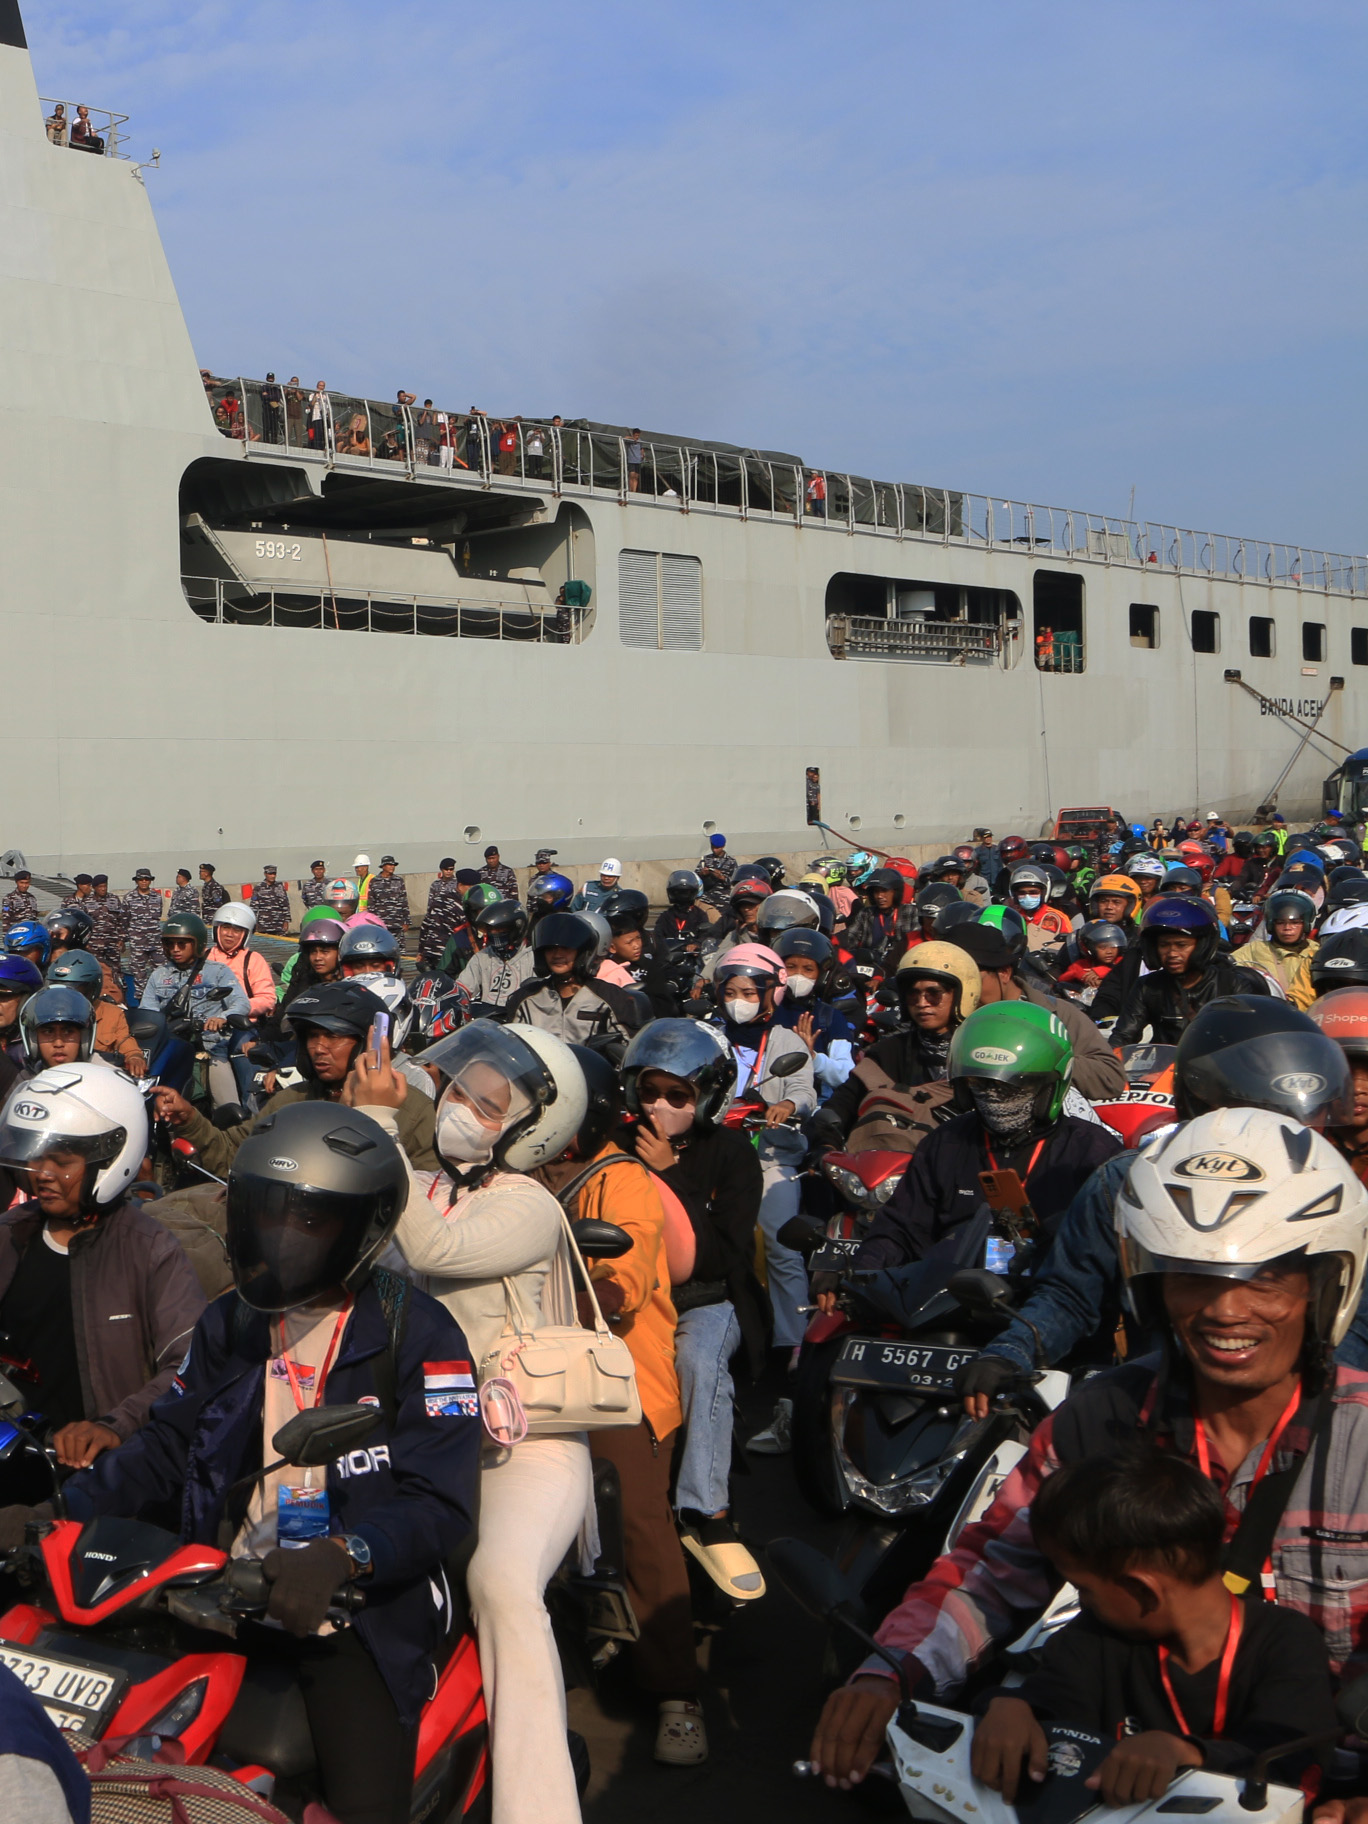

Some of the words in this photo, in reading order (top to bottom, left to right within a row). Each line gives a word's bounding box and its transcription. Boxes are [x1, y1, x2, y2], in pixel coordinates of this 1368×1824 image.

[255, 540, 301, 561] 593-2
[1260, 698, 1294, 717] BANDA
[1297, 699, 1323, 718] ACEH
[490, 972, 512, 993] 25
[974, 1051, 986, 1060] GO
[993, 1054, 1009, 1063] JEK
[16, 1104, 47, 1118] KYT
[270, 1159, 293, 1169] HRV
[1195, 1156, 1240, 1175] Kyt
[851, 1345, 865, 1362] H
[880, 1347, 934, 1369] 5567
[53, 1664, 111, 1710] UVB
